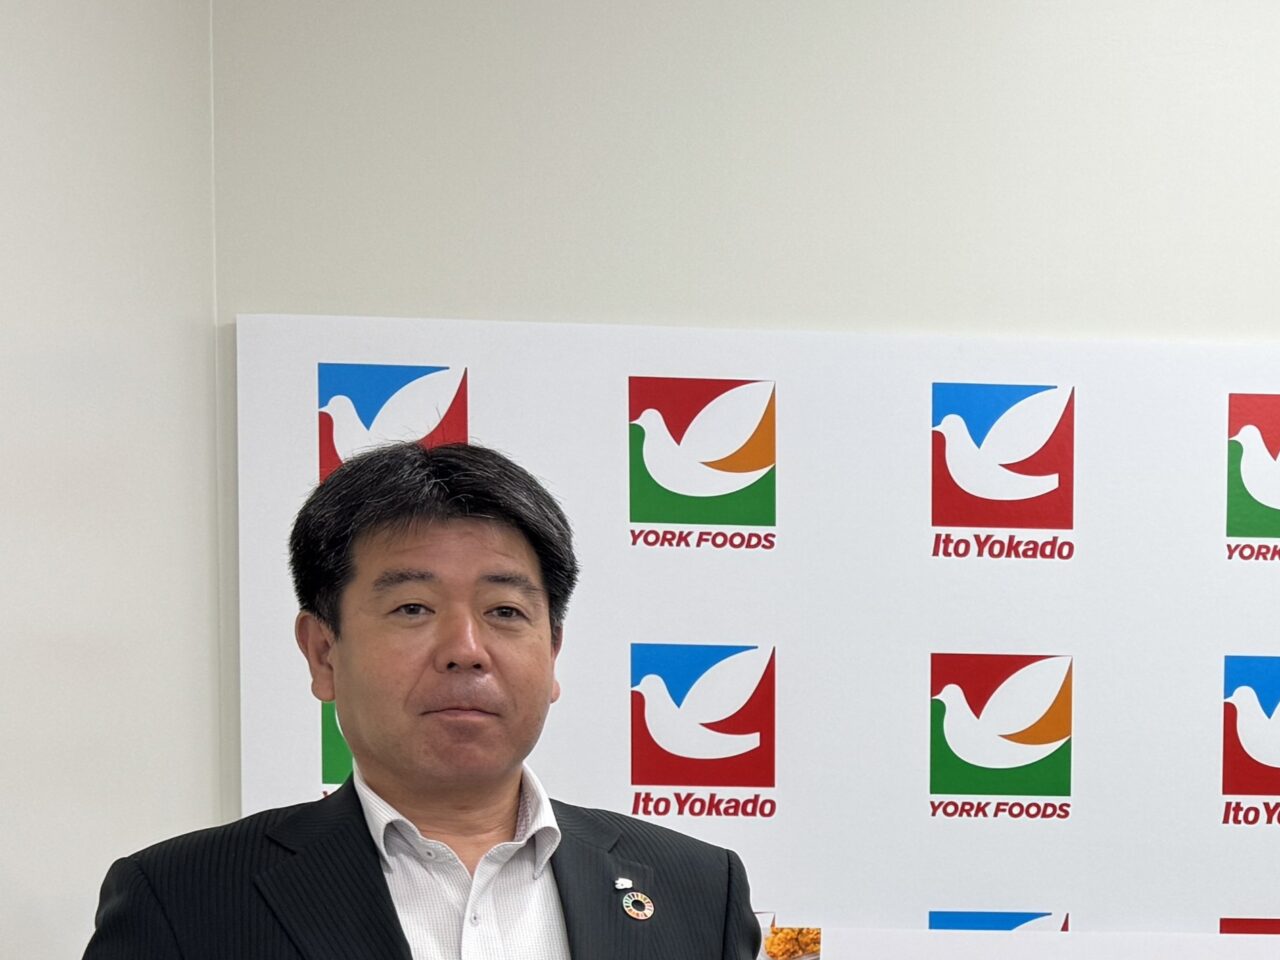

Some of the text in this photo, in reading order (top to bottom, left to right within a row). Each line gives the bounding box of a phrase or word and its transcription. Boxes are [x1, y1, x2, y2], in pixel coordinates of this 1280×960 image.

[631, 529, 775, 550] YORK FOODS
[933, 534, 1075, 561] Ito Yokado
[632, 792, 777, 818] Ito Yokado
[930, 801, 1070, 820] YORK FOODS
[1222, 801, 1261, 826] Ito
